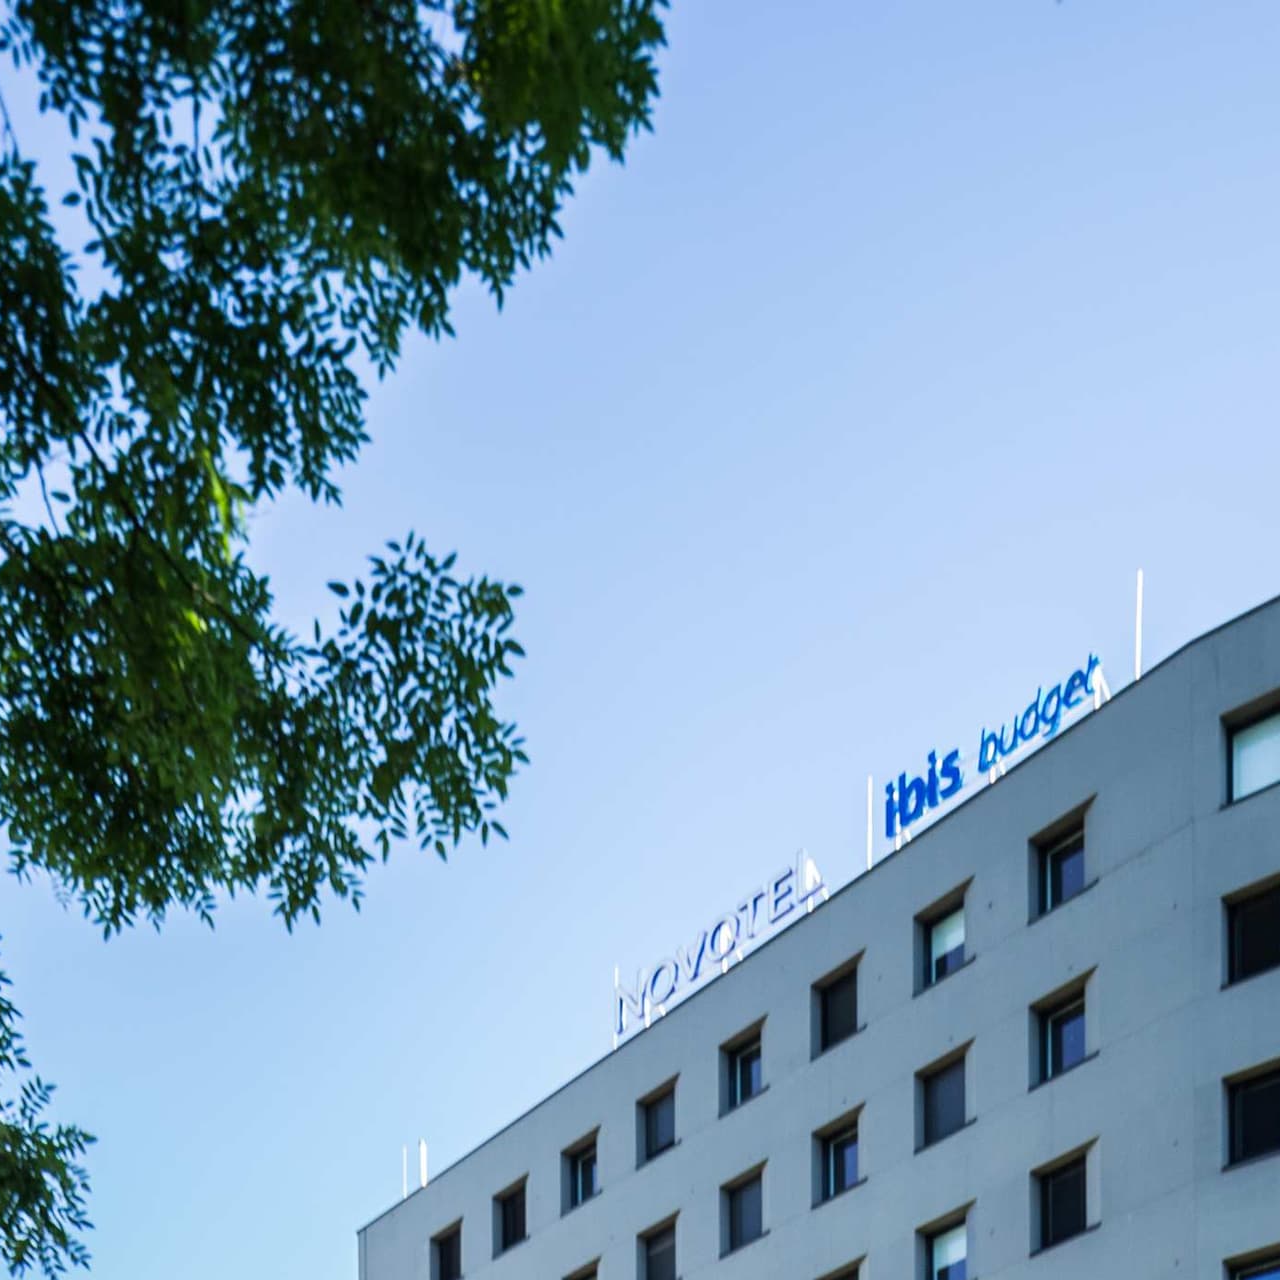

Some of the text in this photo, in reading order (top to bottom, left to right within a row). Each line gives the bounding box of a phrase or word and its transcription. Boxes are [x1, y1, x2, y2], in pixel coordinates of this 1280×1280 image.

[885, 653, 1101, 838] ibis budget
[615, 849, 825, 1034] NOVOTEL
